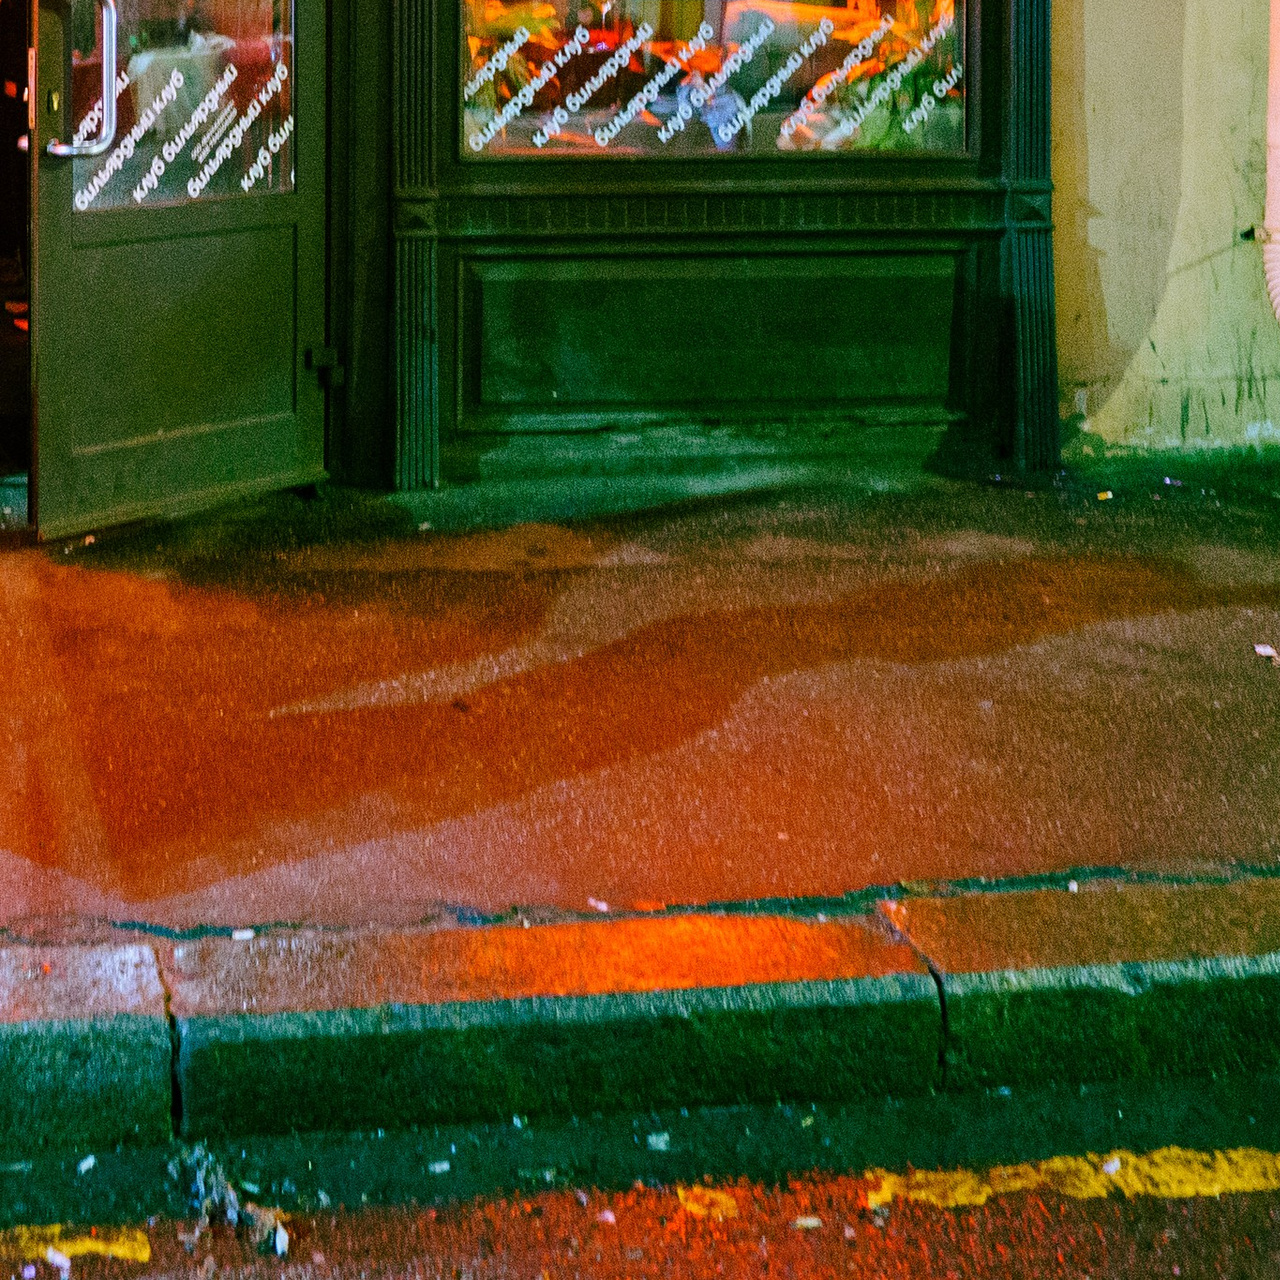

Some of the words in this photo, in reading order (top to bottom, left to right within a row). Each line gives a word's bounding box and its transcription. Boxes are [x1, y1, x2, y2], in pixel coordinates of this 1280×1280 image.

[469, 60, 557, 152] бильярдный
[554, 24, 590, 68] клуб
[532, 105, 568, 148] клуб
[565, 21, 653, 113] бильярдный
[594, 57, 681, 146] бильярдный
[678, 20, 714, 63] клуб
[657, 100, 692, 144] клуб
[690, 17, 775, 108] бильярдный
[800, 16, 834, 58] клуб
[75, 108, 155, 211] бильярдный
[152, 67, 184, 115] клуб
[133, 155, 166, 204] клуб
[162, 63, 238, 163] бильярдный
[187, 99, 261, 198] бильярдный
[259, 60, 288, 106] клуб
[241, 146, 270, 192] клуб
[902, 90, 936, 135] клуб
